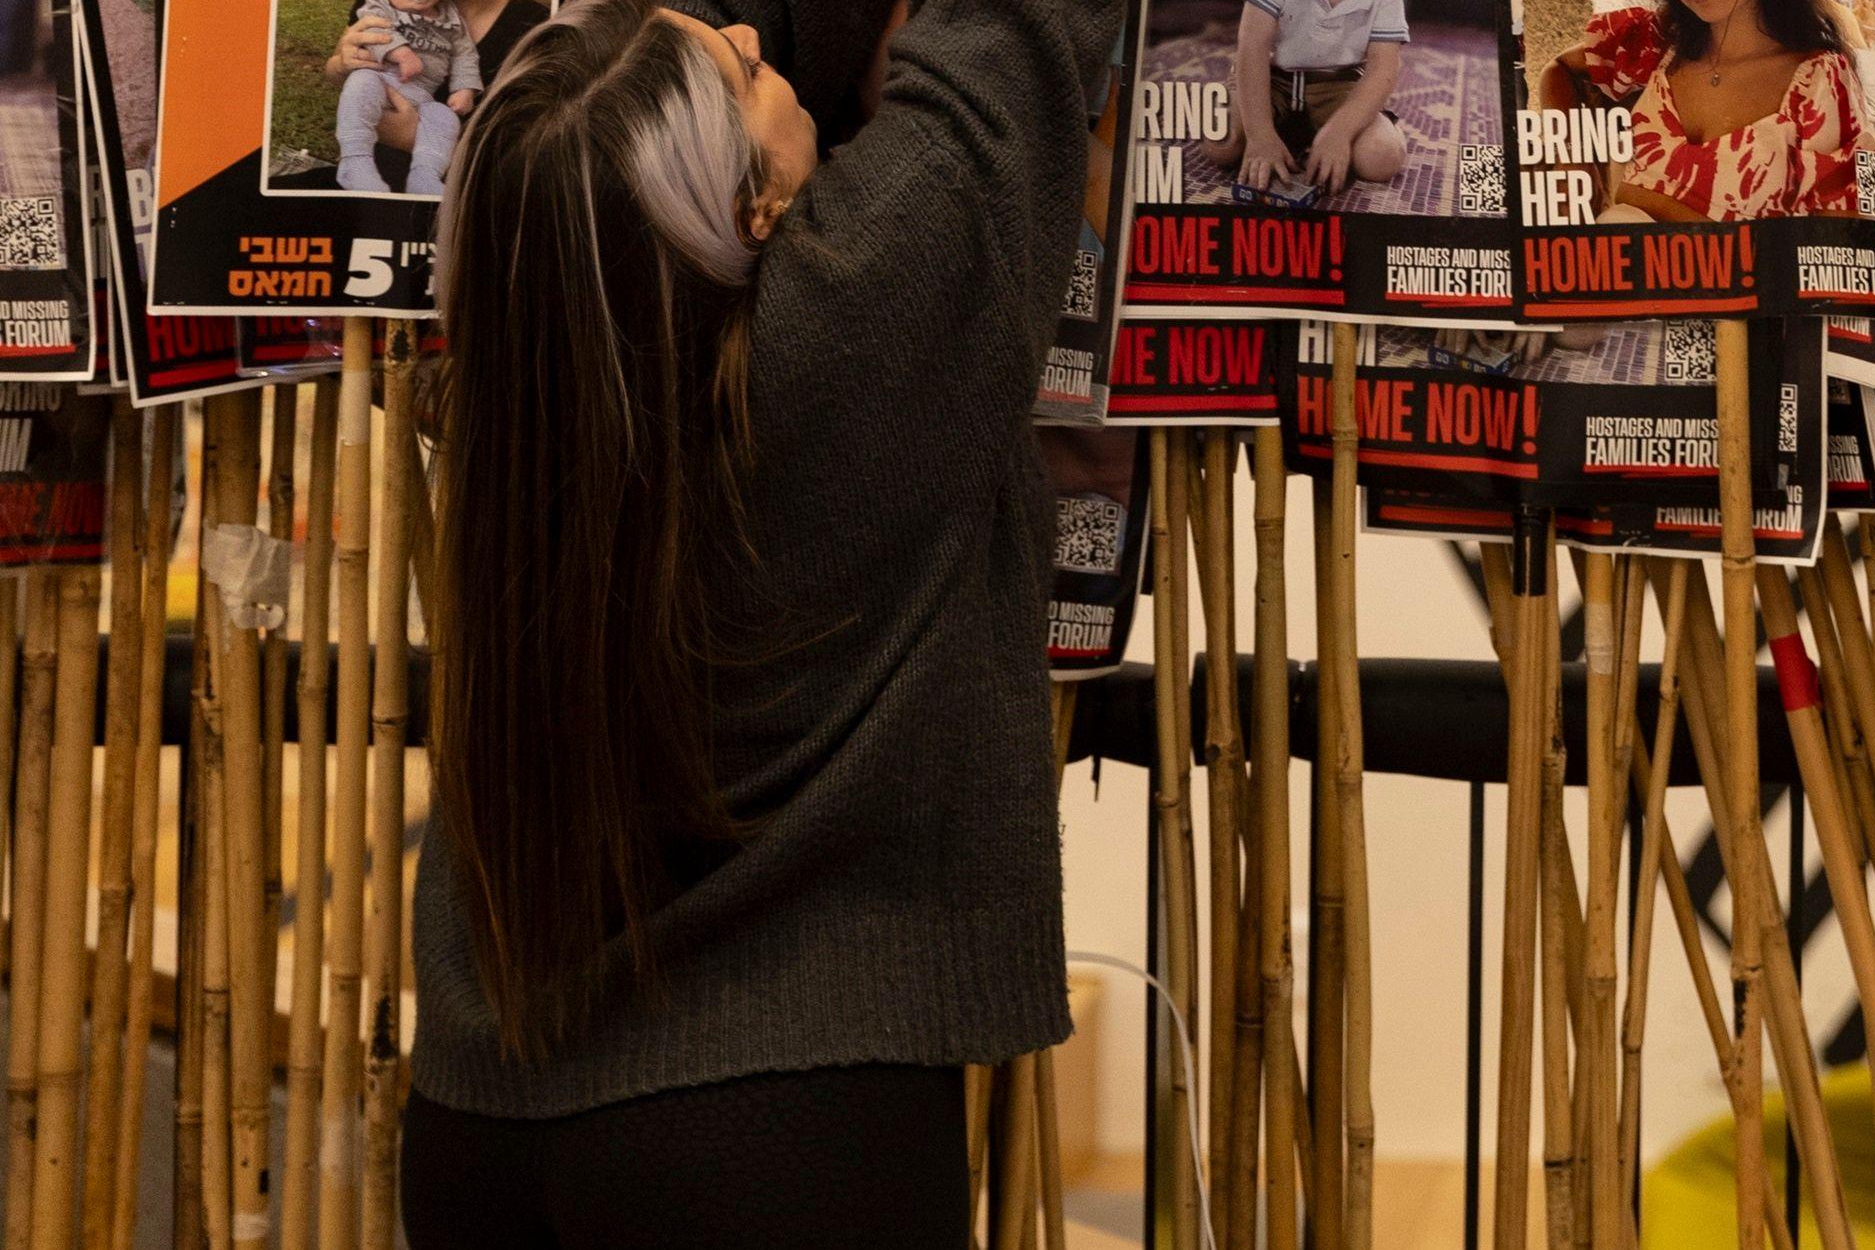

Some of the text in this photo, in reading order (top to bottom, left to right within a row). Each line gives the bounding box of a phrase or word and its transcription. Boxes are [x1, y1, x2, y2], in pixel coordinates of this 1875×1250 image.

[1136, 80, 1230, 142] RING
[1516, 106, 1634, 166] BRING
[1136, 145, 1183, 205] IM
[1520, 169, 1597, 227] HER
[239, 236, 334, 264] בשבי
[1127, 215, 1344, 282] OME NOW!
[1386, 245, 1511, 270] HOSTAGES AND MISS
[1524, 225, 1756, 293] HOME NOW!
[1797, 246, 1854, 268] HOSTAGES
[1855, 249, 1874, 269] AND
[228, 269, 332, 298] חמאס
[343, 237, 394, 298] 5
[1386, 266, 1467, 297] FAMILIES
[1799, 263, 1872, 295] FAMILIES
[12, 300, 70, 321] MISSING
[6, 319, 72, 348] FORUM
[1298, 374, 1541, 456] HME NOW!
[1585, 416, 1683, 439] HOSTAGES AND
[1585, 436, 1671, 468] FAMILIES
[1060, 601, 1115, 624] MISSING
[1050, 619, 1114, 652] FORUM
